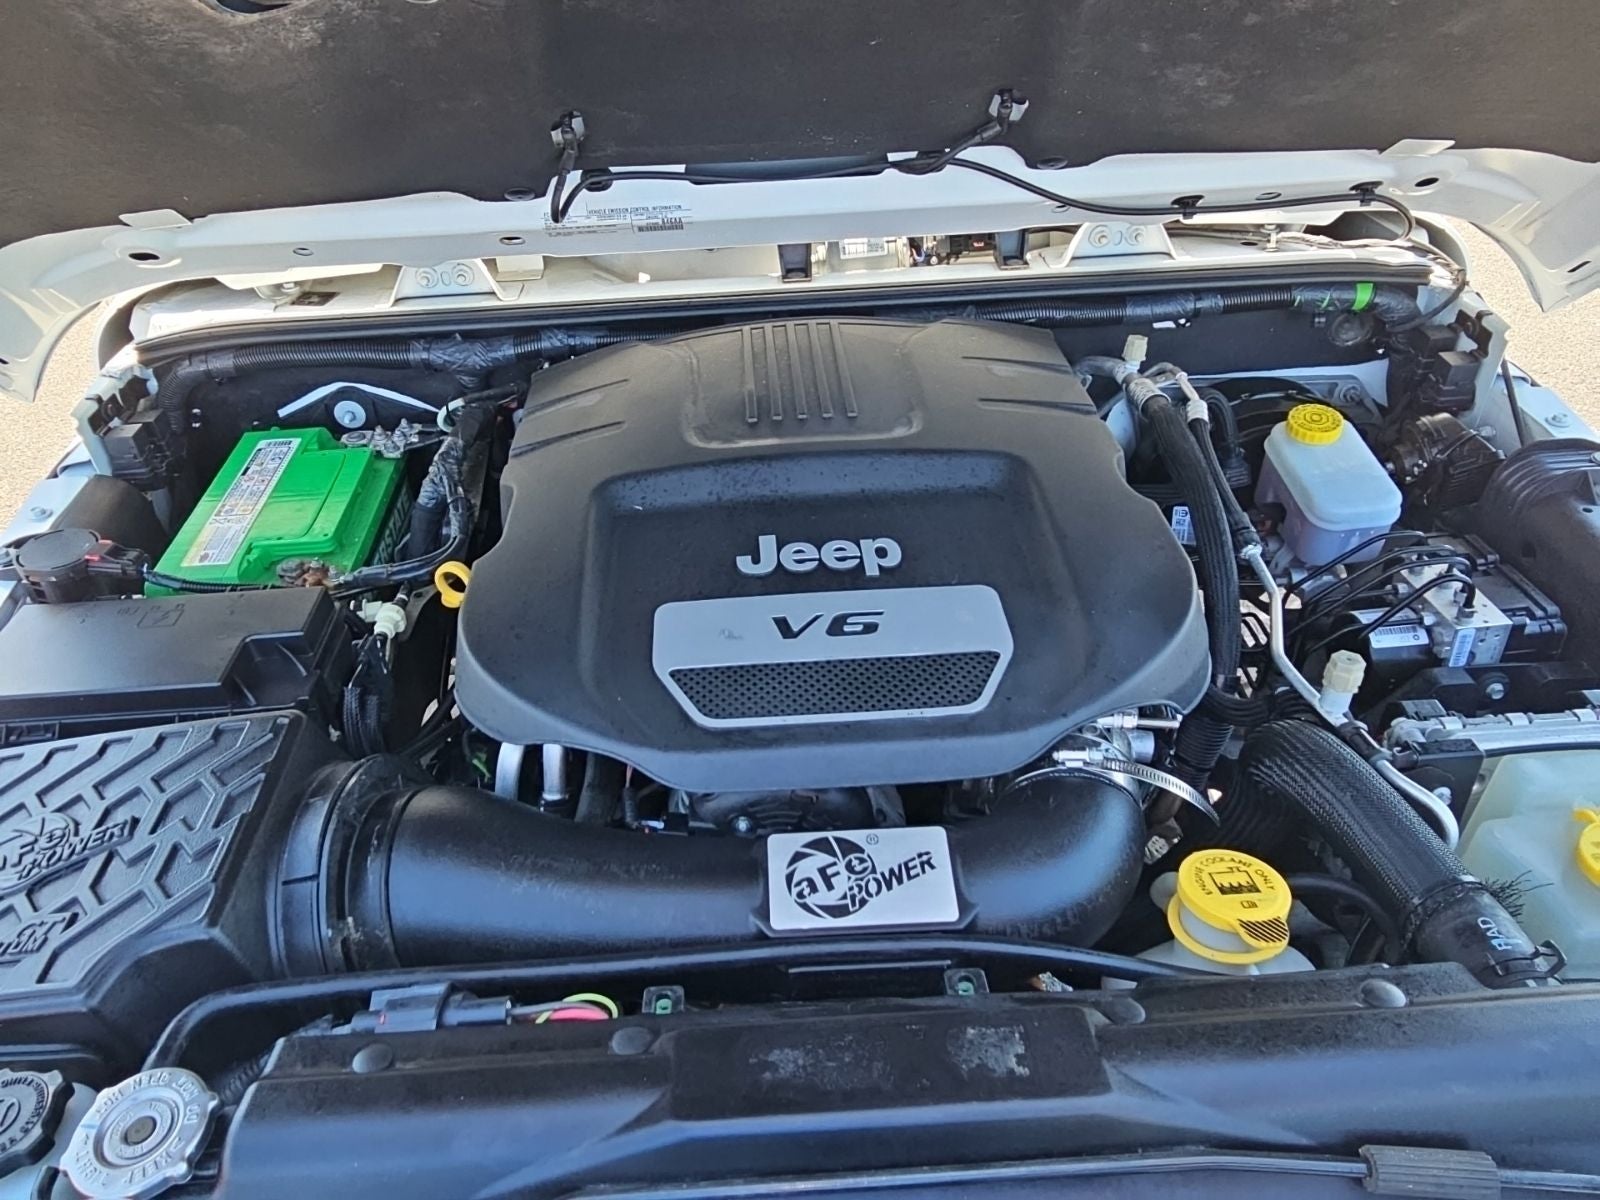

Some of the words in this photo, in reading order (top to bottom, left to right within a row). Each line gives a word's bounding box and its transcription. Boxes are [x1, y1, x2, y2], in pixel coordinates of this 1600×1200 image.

[652, 204, 682, 212] INFORMATION
[735, 534, 902, 577] Jeep
[771, 609, 886, 640] V6
[847, 850, 938, 912] POWER
[1200, 856, 1253, 868] COOLANT
[1254, 868, 1277, 892] ONLY
[1477, 916, 1522, 951] RAD
